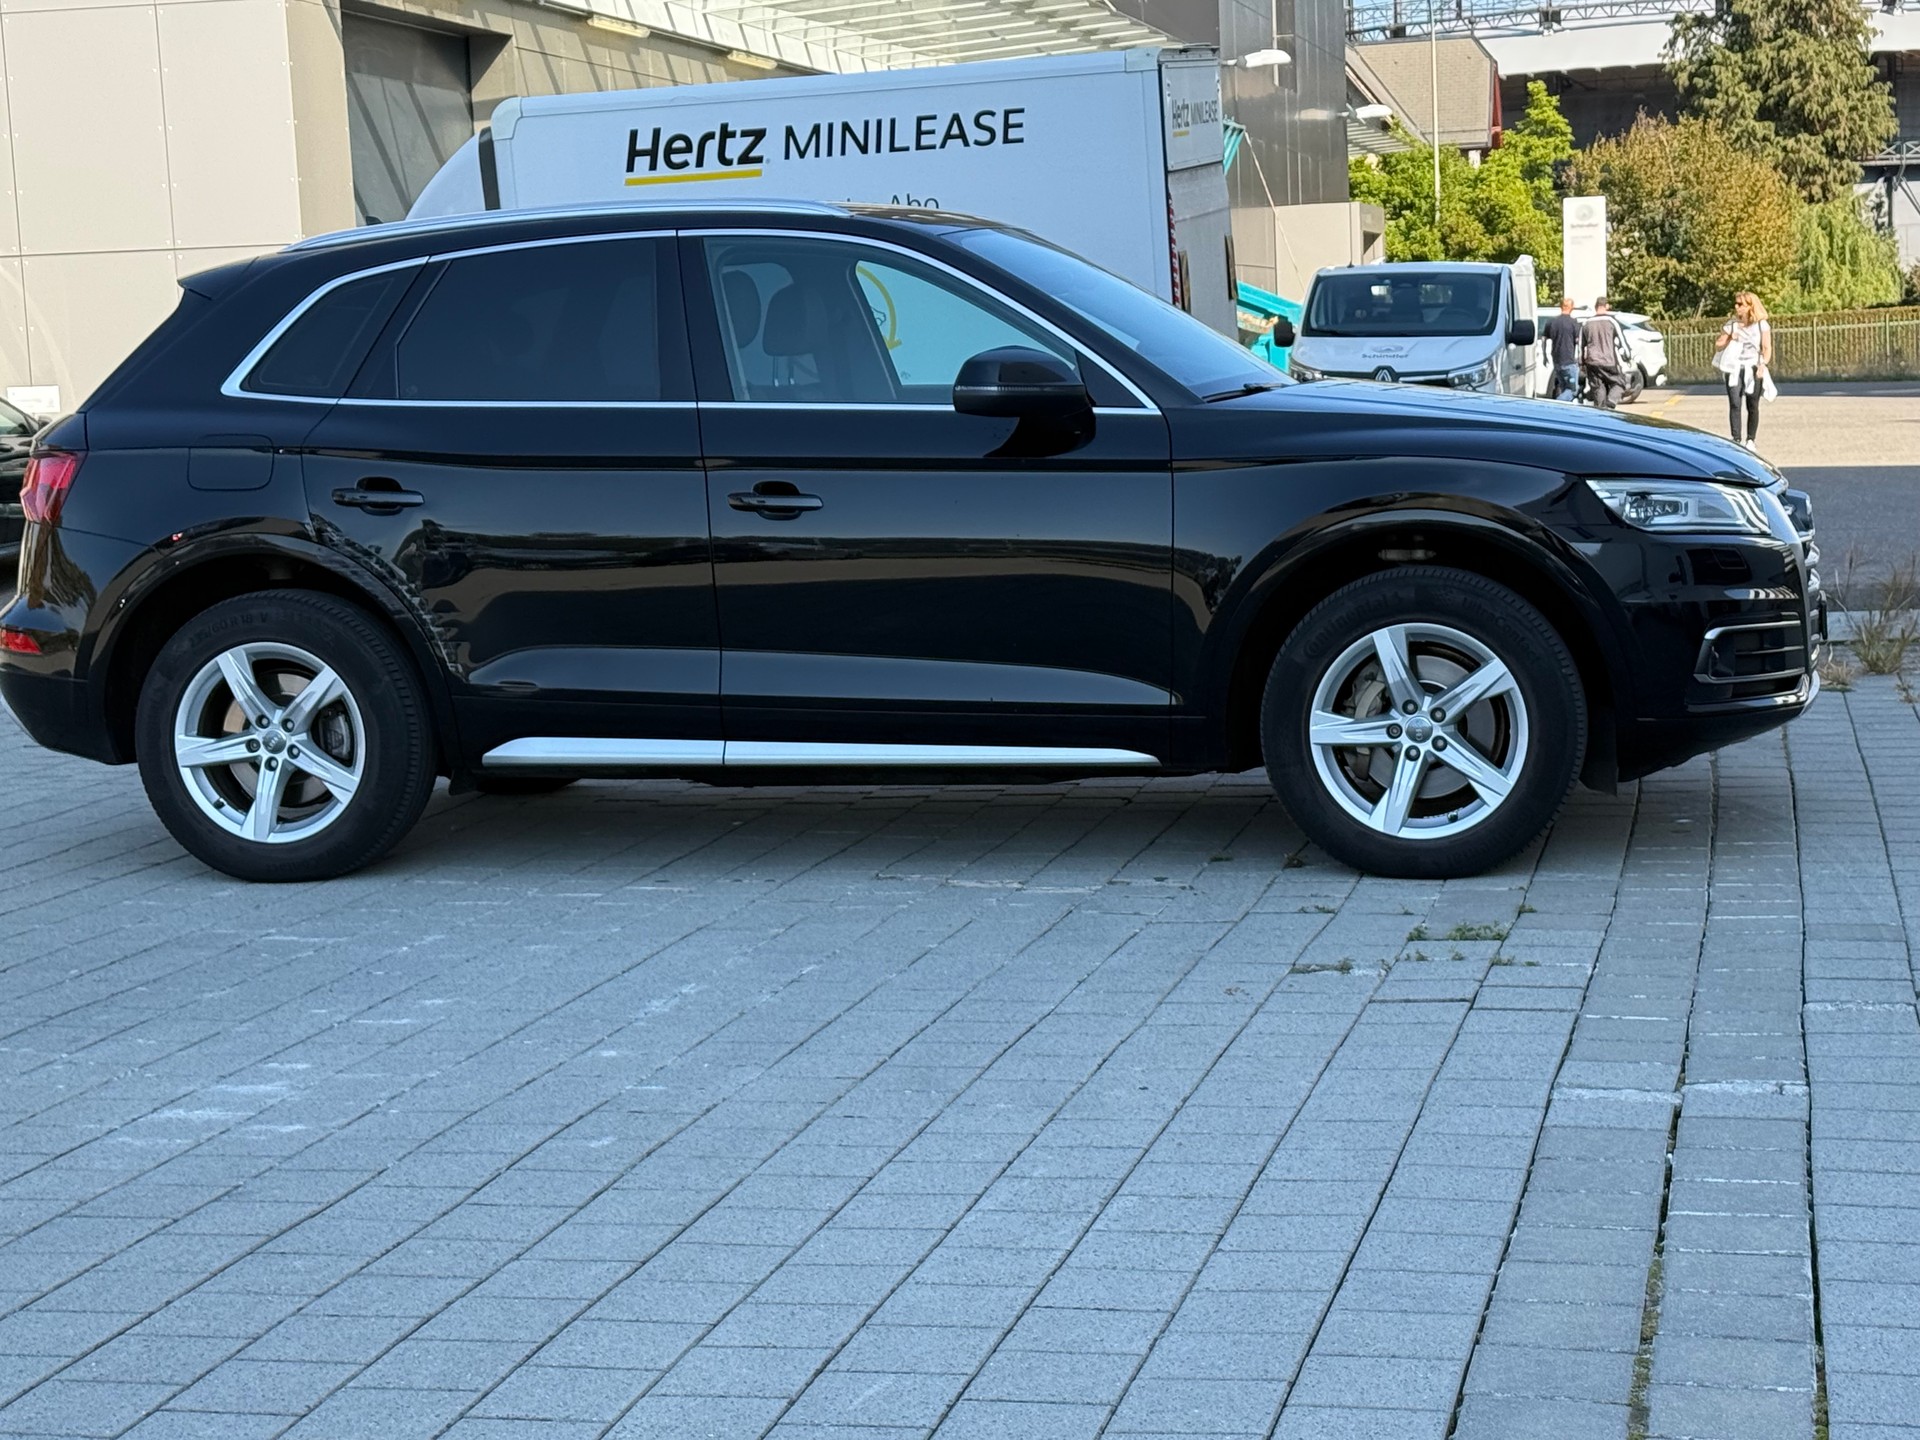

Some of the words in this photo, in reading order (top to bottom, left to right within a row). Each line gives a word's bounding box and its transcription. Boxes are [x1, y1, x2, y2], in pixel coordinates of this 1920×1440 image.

[1171, 98, 1190, 129] Hertz
[625, 122, 768, 173] Hertz
[783, 107, 1026, 161] MINILEASE
